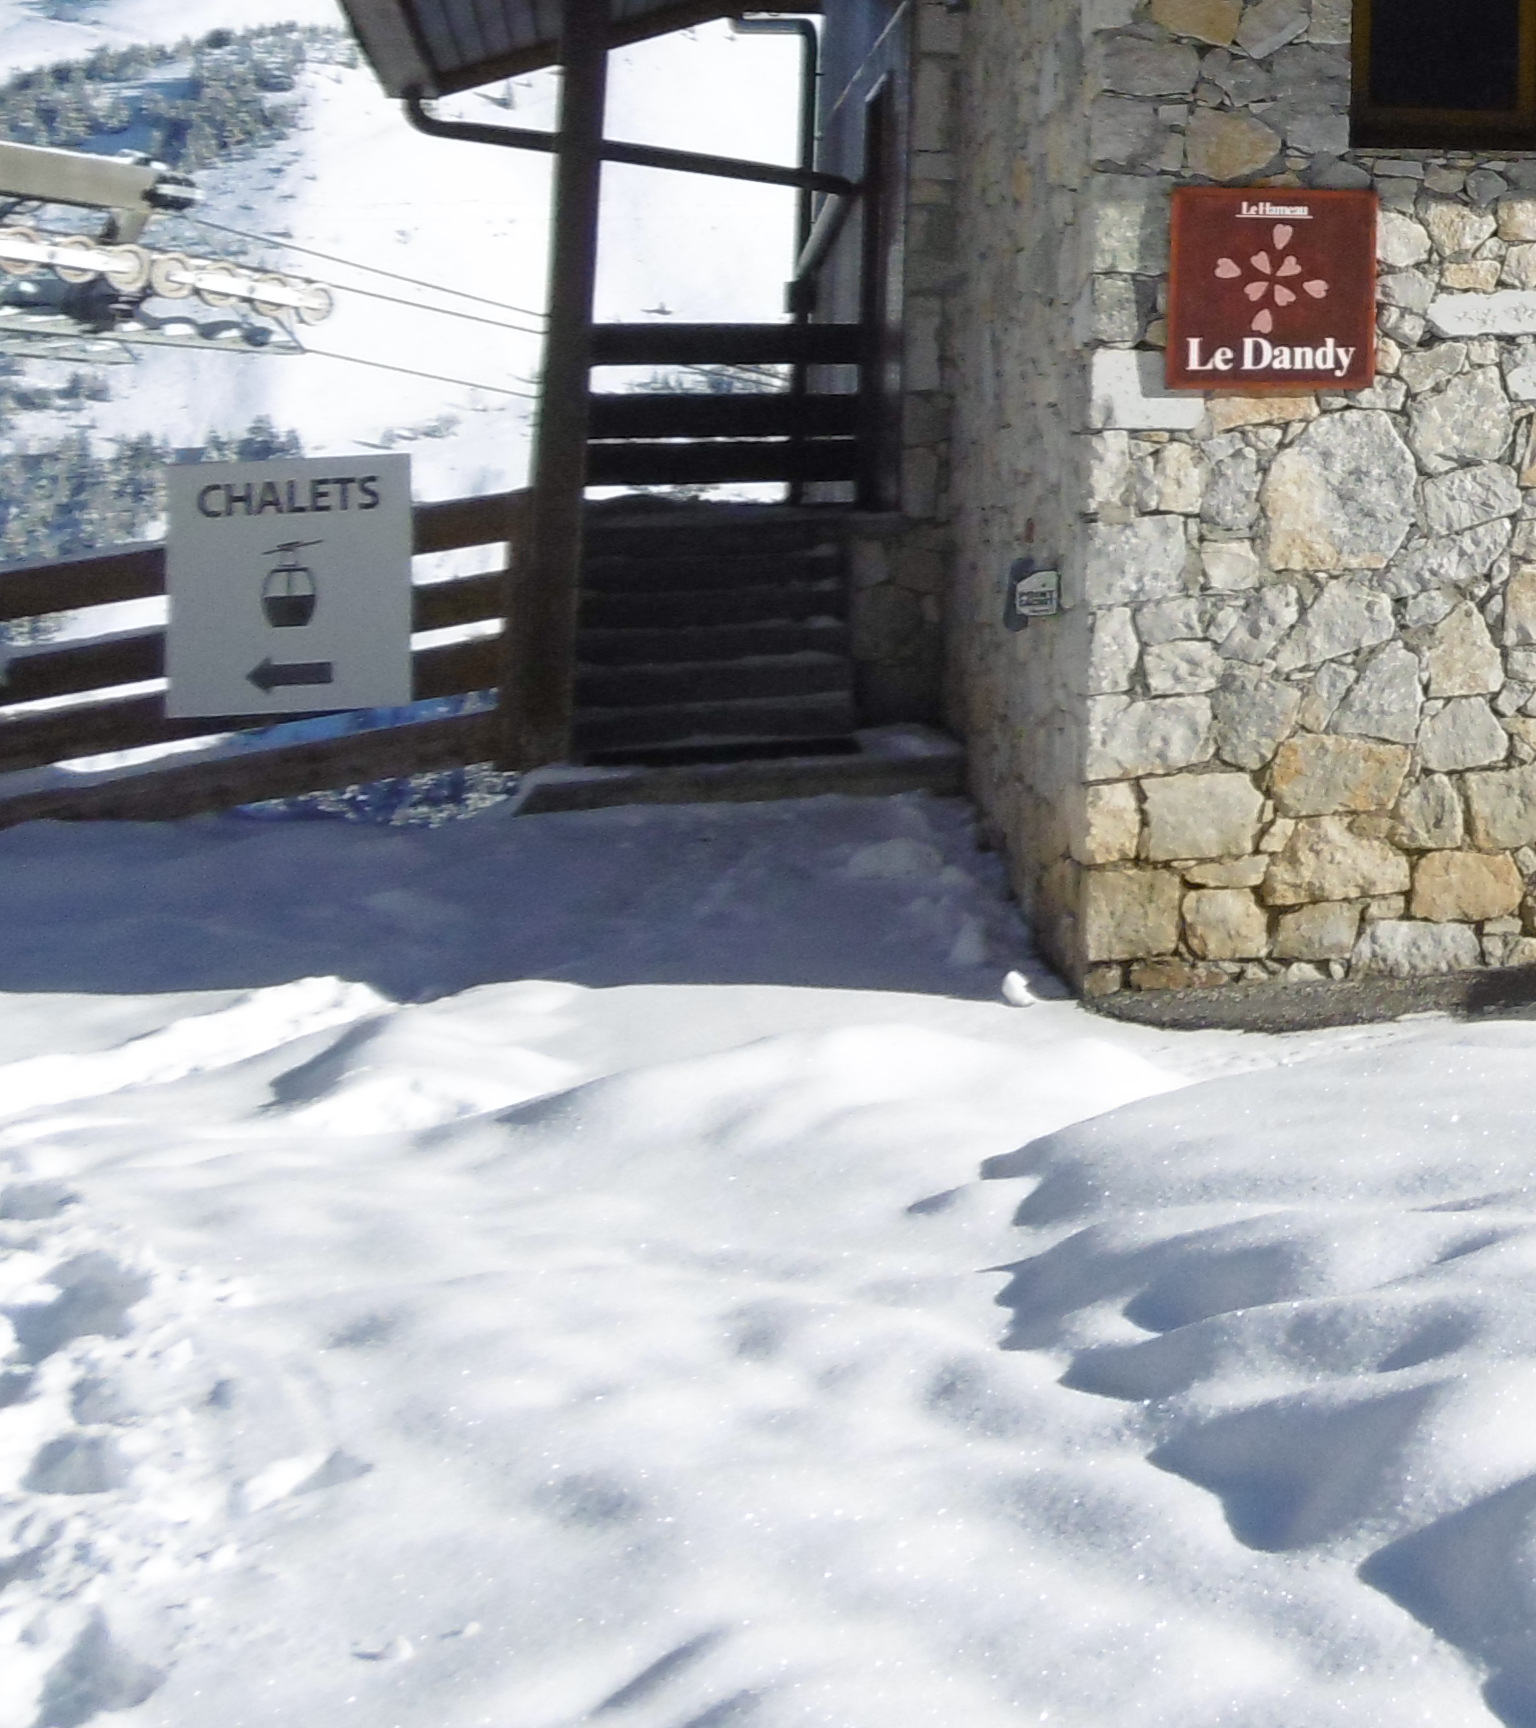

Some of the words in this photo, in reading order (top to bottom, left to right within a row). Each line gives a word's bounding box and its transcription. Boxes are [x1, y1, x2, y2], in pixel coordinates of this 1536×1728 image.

[1185, 337, 1234, 371] Le
[1240, 337, 1356, 377] Dandy
[197, 475, 380, 518] CHALETS
